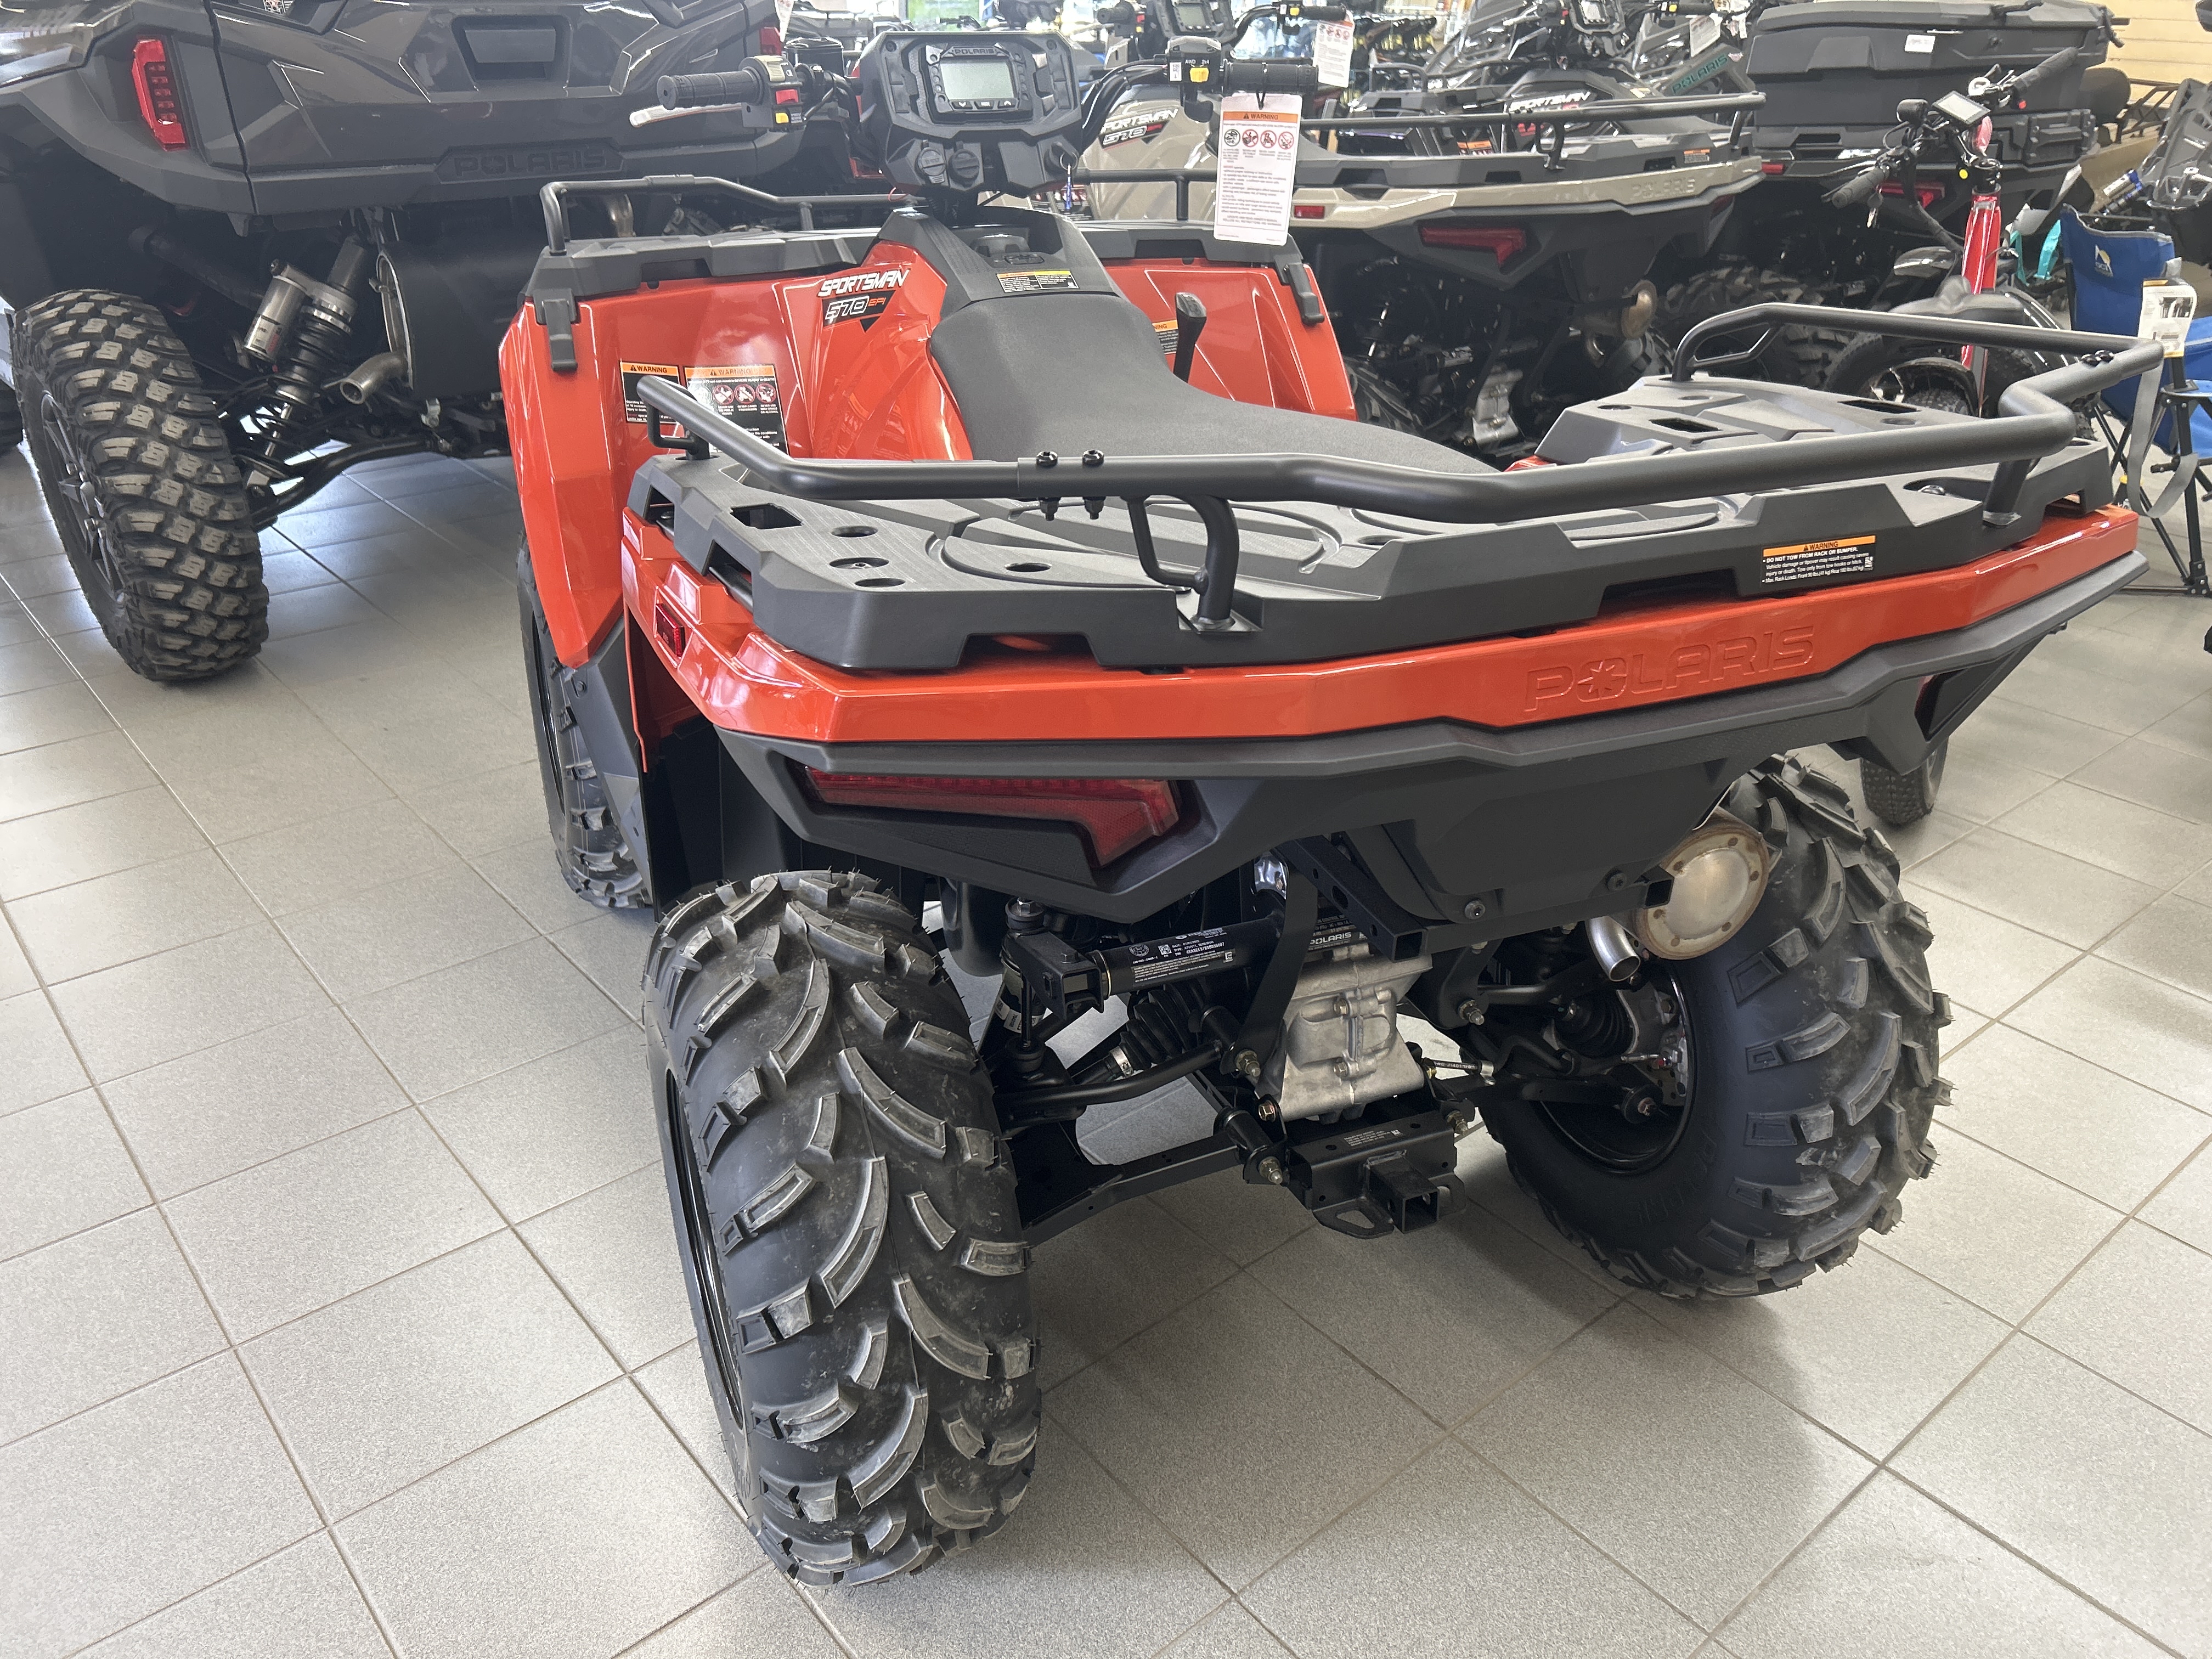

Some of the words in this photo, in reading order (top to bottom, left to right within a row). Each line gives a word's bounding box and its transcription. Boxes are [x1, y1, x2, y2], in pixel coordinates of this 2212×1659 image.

[1672, 53, 1728, 94] POLARIS
[454, 148, 605, 177] POLARIS
[1630, 177, 1695, 200] POLARIS
[817, 269, 911, 297] SPORTSMAN
[825, 295, 870, 321] 570
[868, 297, 887, 307] EFI
[1809, 541, 1838, 551] WARNING
[1525, 625, 1814, 712] POLARIS
[1310, 932, 1352, 945] POLARIS
